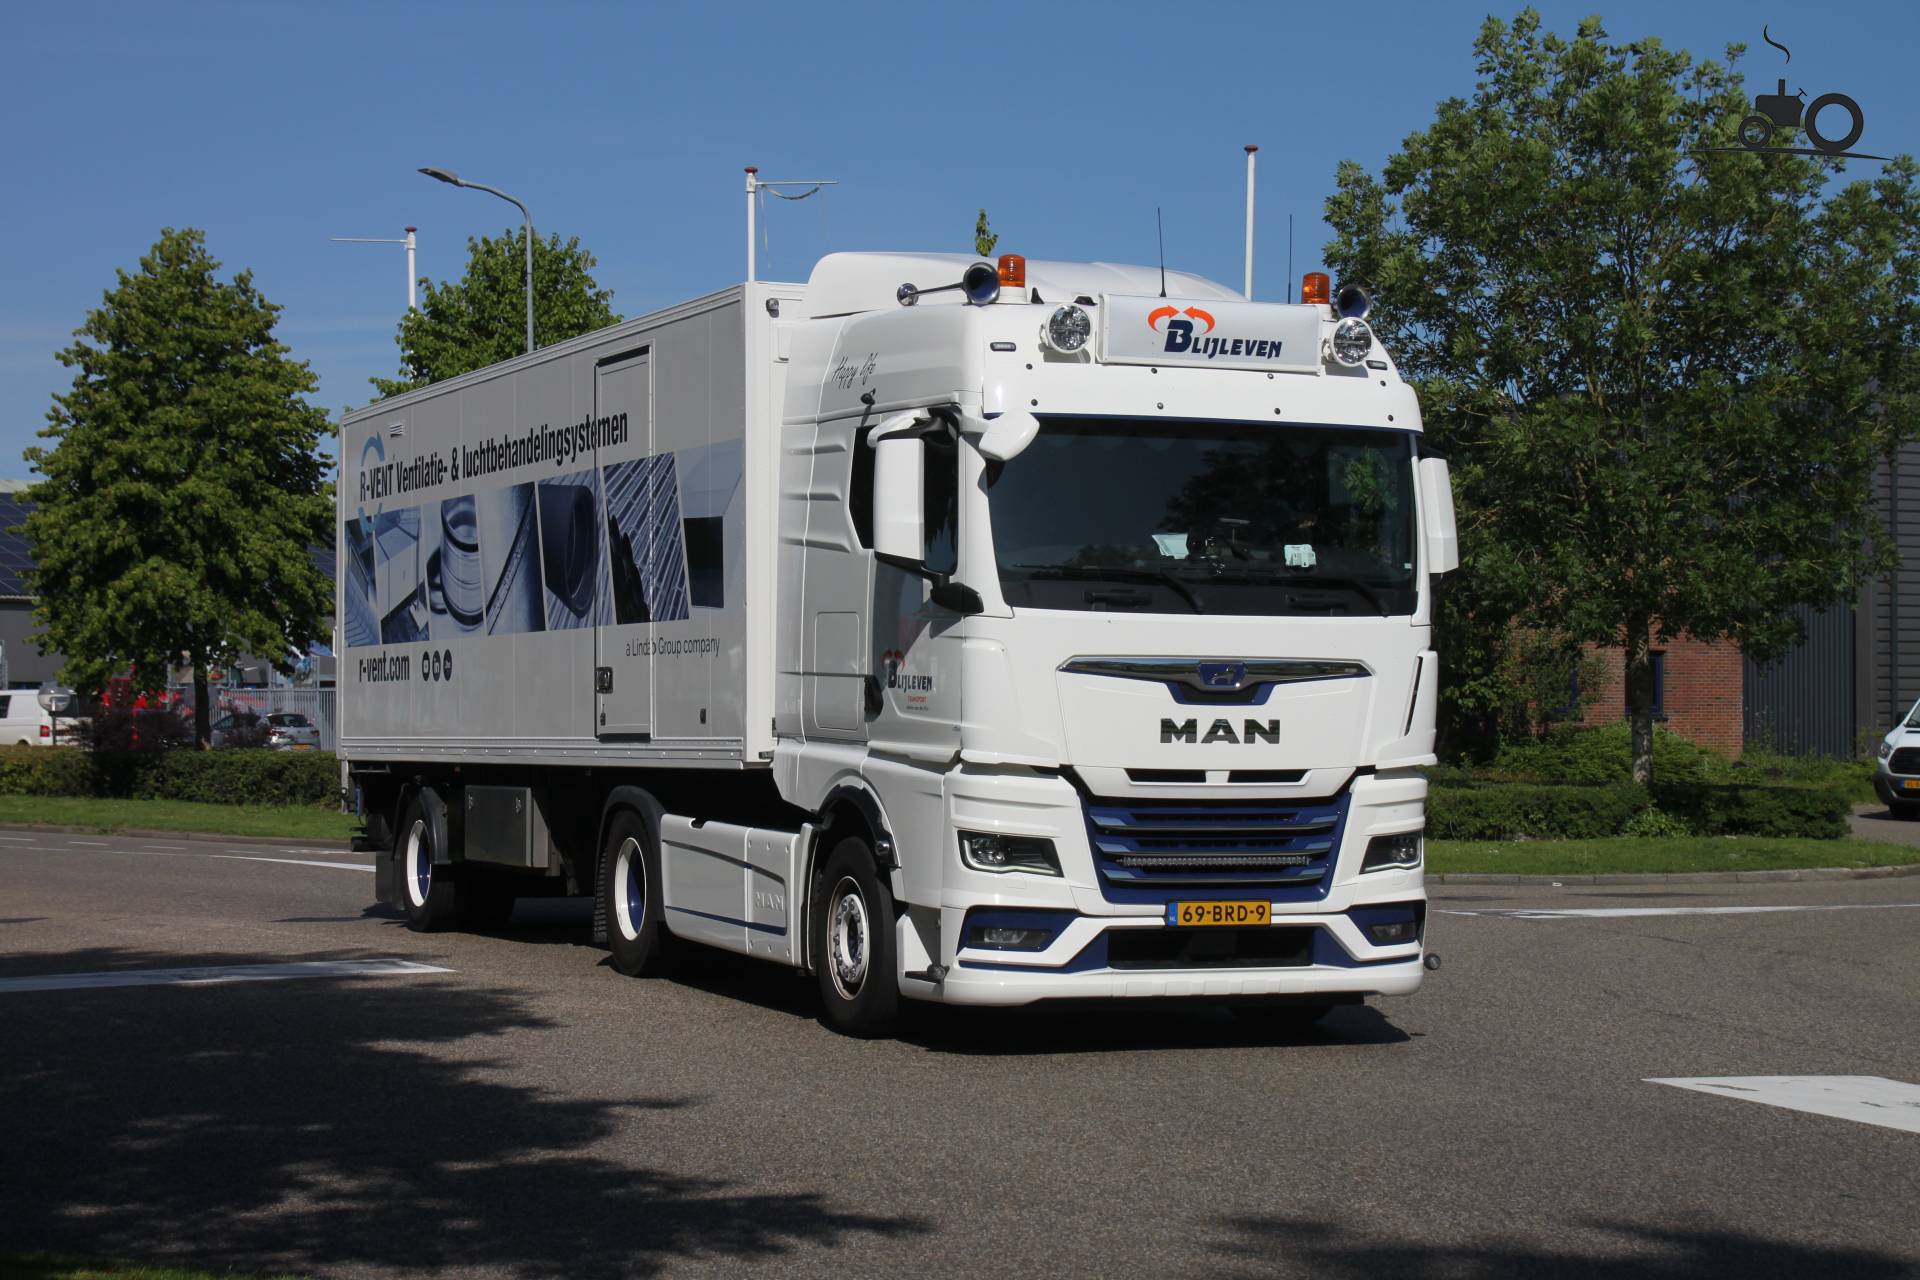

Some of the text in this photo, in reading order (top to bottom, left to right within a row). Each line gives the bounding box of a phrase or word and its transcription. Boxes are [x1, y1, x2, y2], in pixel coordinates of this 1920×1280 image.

[1164, 319, 1282, 359] BLIJLEVEN
[360, 412, 628, 502] R-VENT Ventilatie- & luchtbehandelingsystemen
[626, 643, 631, 656] a
[658, 637, 681, 659] Group
[684, 637, 719, 658] company
[360, 650, 410, 682] r-vent.com
[887, 660, 933, 693] BLIJLEVEN
[1160, 719, 1280, 744] MAN
[1182, 904, 1266, 923] 69-BRD-9
